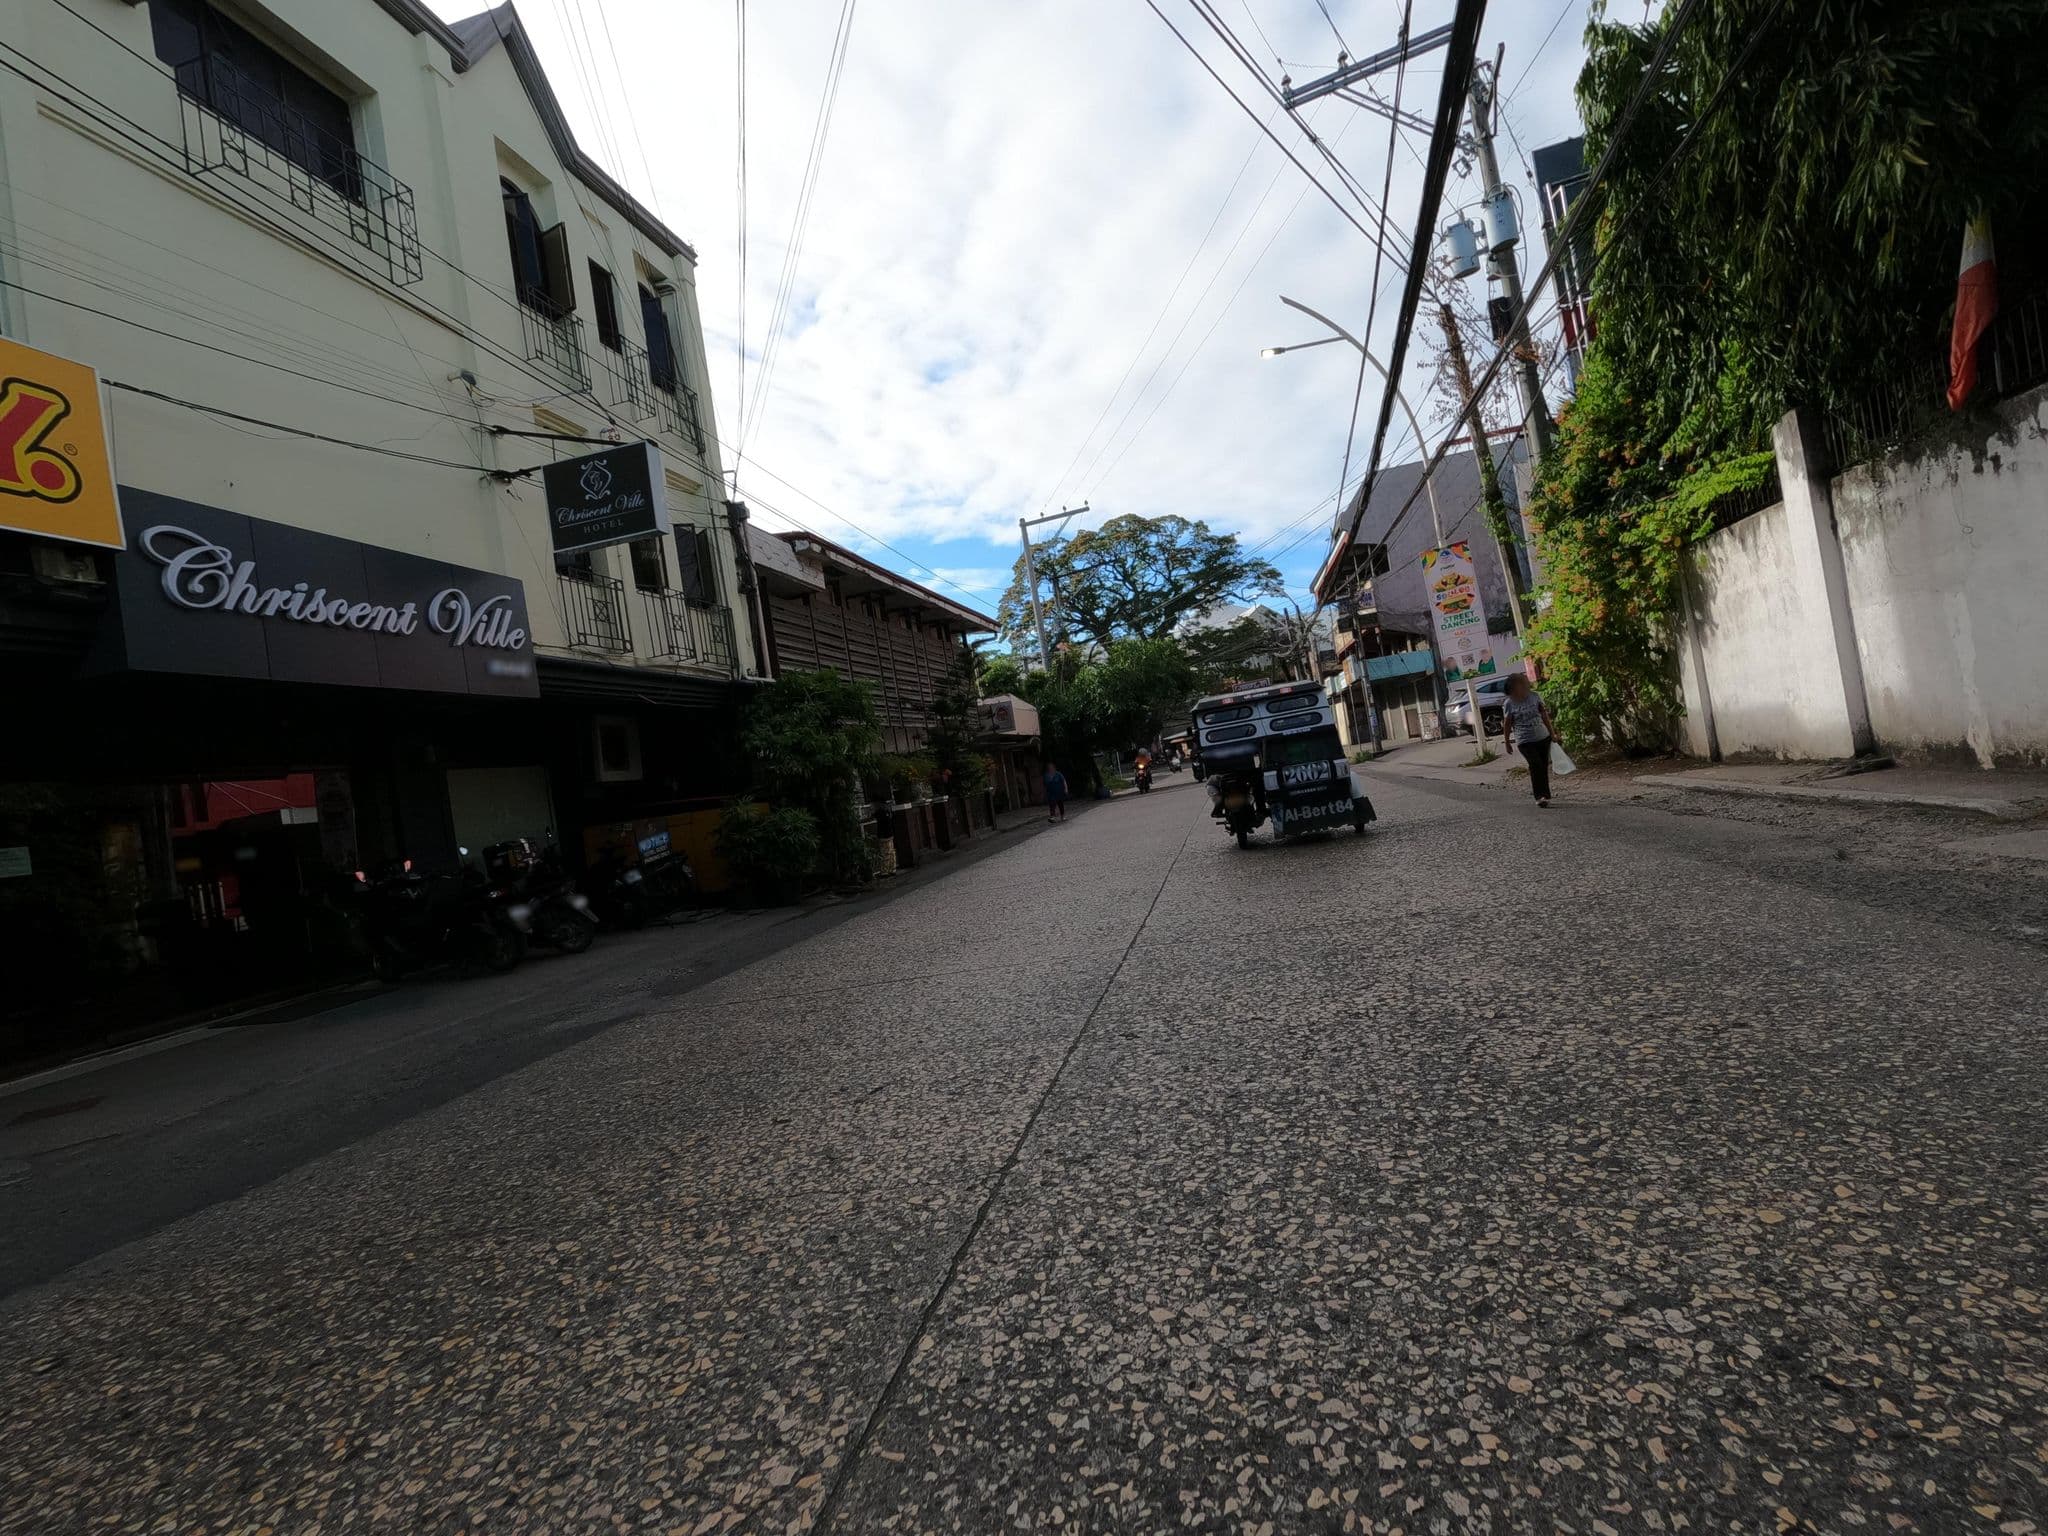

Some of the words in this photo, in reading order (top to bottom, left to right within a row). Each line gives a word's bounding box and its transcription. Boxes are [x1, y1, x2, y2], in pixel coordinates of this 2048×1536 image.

[555, 504, 613, 524] Chriscent
[615, 489, 645, 511] Ville
[583, 519, 625, 534] HOTEL
[138, 524, 417, 636] Chriscent
[428, 587, 527, 651] Ville
[1440, 616, 1480, 630] DANCING
[1443, 610, 1475, 623] STREET
